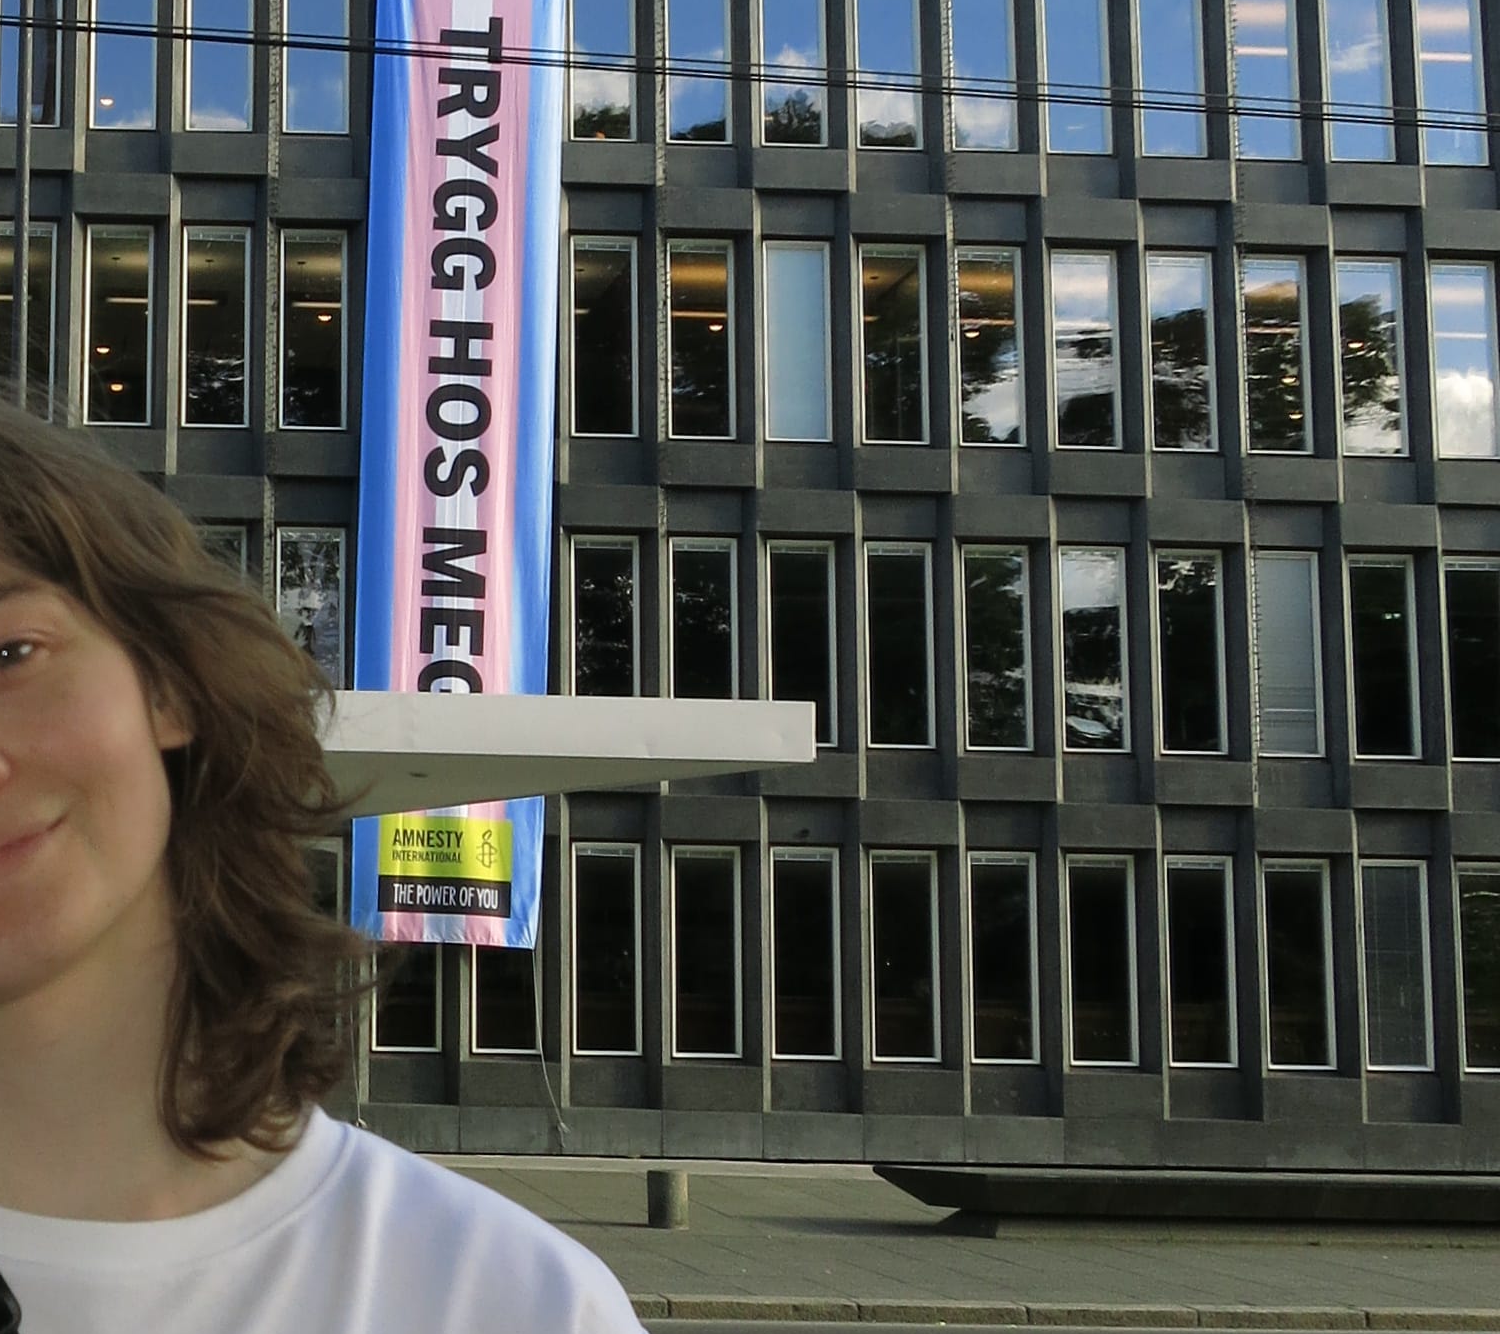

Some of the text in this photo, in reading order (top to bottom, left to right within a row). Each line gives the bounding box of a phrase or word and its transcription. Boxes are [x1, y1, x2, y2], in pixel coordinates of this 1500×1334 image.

[431, 17, 503, 291] TRYGG
[424, 319, 494, 497] HOS
[392, 828, 463, 848] AMNESTY
[391, 850, 462, 863] INTERNATIONAL
[393, 883, 498, 909] THE POWER OF YOU
